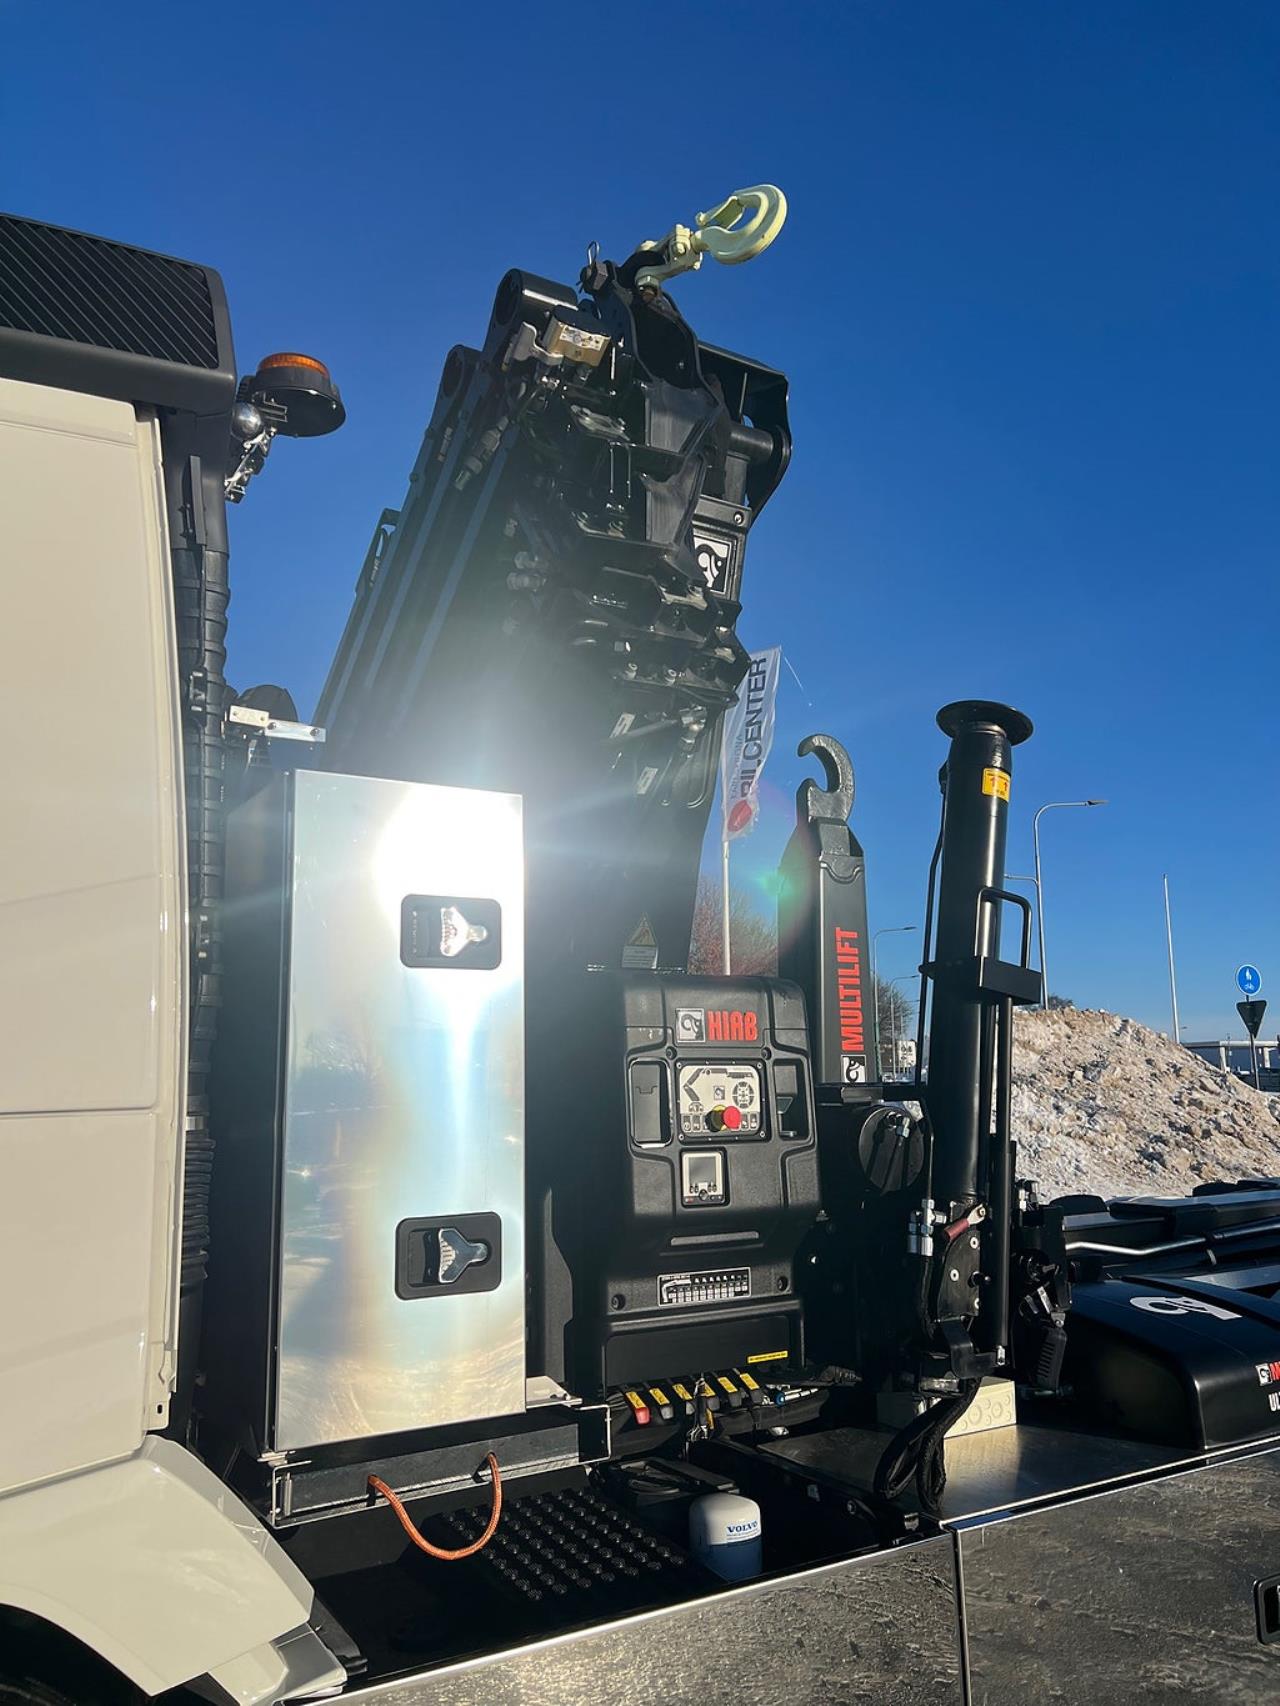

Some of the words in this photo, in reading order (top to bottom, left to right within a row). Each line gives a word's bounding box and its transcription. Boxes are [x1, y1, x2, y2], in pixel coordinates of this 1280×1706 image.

[836, 926, 864, 1052] MULTILIFT
[706, 1010, 758, 1041] HIAB
[727, 1520, 758, 1533] VOLVO
